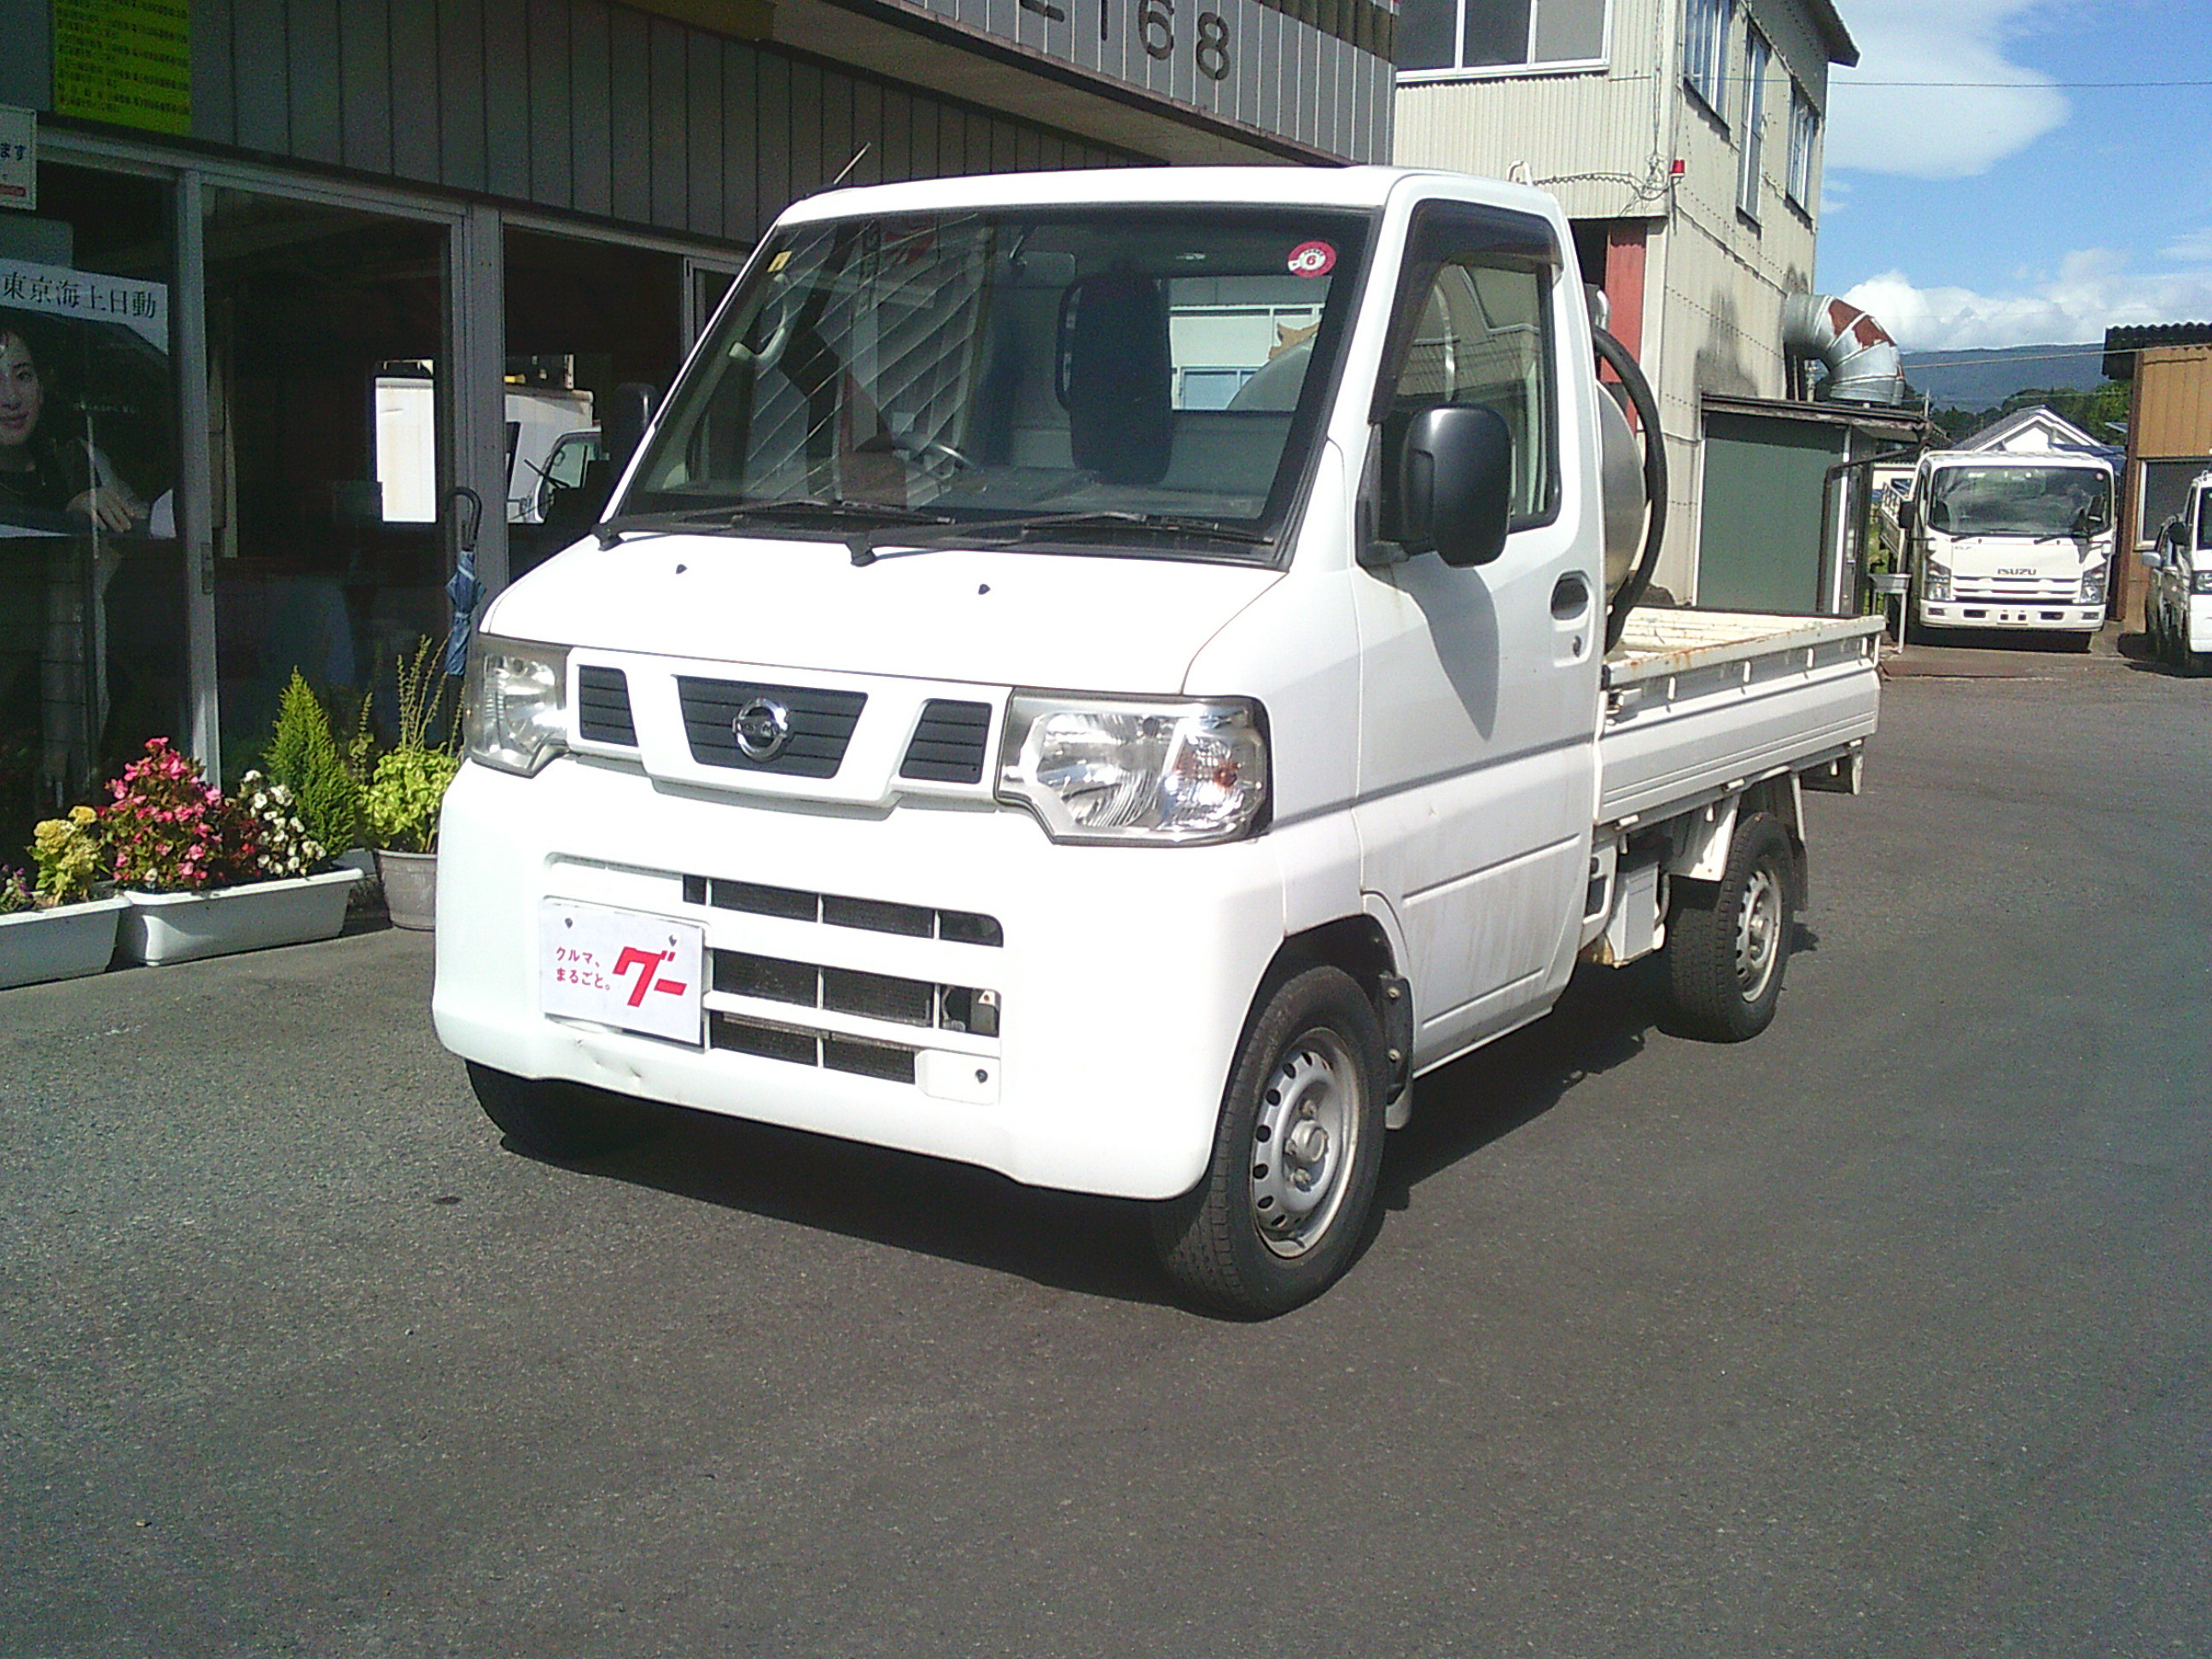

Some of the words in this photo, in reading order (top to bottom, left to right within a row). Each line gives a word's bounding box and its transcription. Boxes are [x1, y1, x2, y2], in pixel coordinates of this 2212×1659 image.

[1019, 0, 1231, 80] 168
[3, 271, 156, 318] 東京海上日動
[556, 946, 600, 968] クルマ、
[556, 968, 610, 991] まるごと。
[612, 946, 688, 1007] グー
